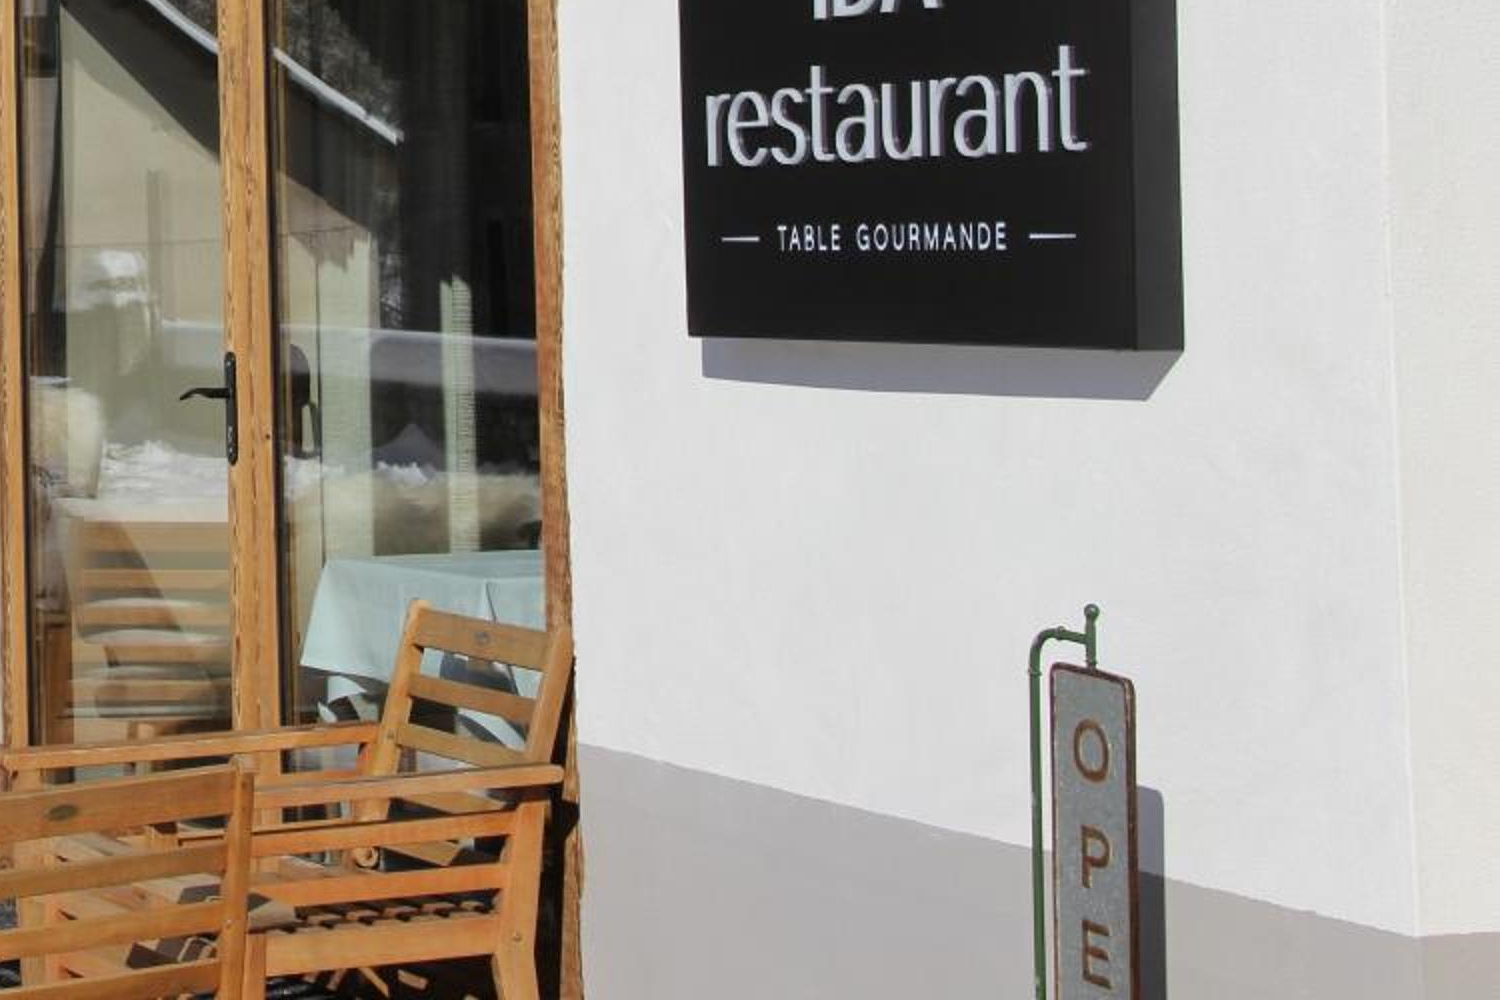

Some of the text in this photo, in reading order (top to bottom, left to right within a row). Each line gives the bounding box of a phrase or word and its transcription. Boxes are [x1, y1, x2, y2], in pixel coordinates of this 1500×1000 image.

[706, 45, 1090, 166] restaurant
[777, 221, 1008, 252] TABLE GOURMANDE
